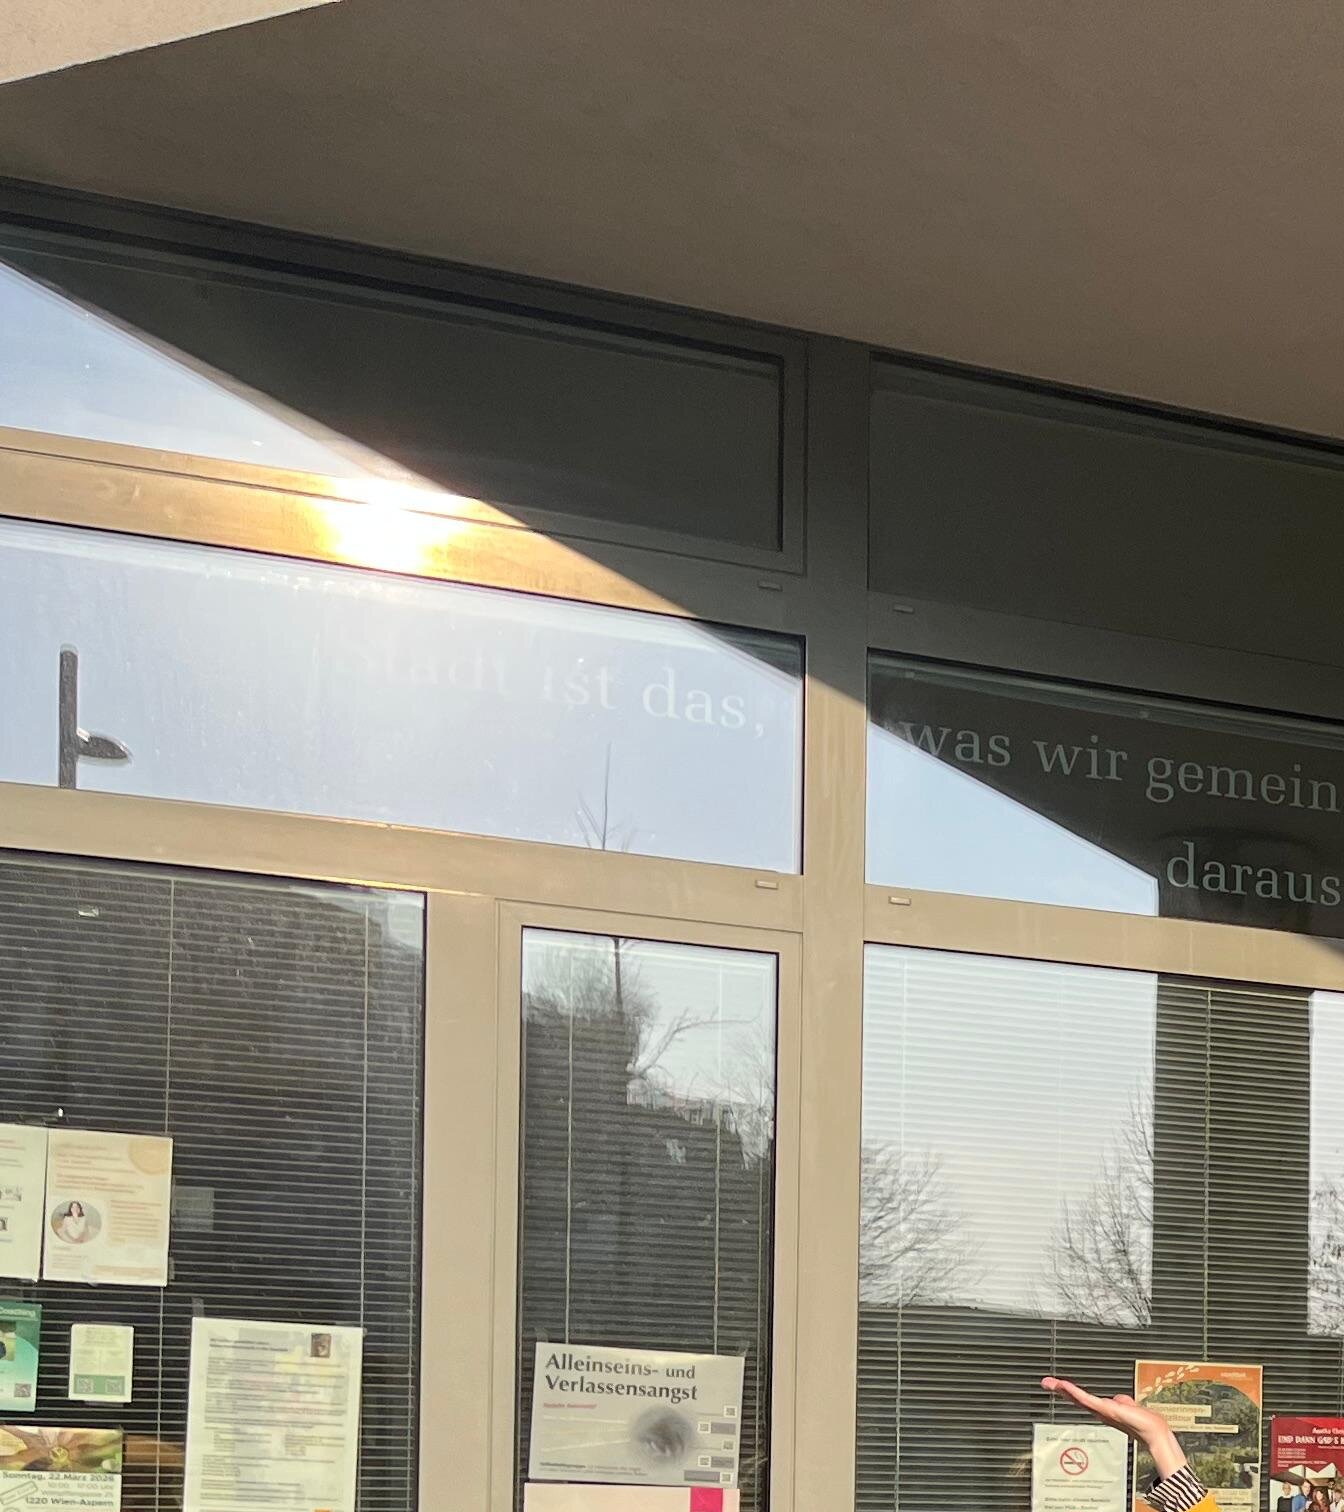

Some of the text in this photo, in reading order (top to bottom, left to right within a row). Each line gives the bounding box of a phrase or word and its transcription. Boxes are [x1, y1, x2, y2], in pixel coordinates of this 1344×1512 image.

[540, 656, 618, 711] ist
[642, 665, 766, 740] das,
[897, 721, 1011, 767] was
[1032, 733, 1128, 783] wir
[1165, 841, 1342, 908] daraus
[545, 1353, 696, 1379] Alleinseins- und
[545, 1374, 698, 1404] Verlassensangst
